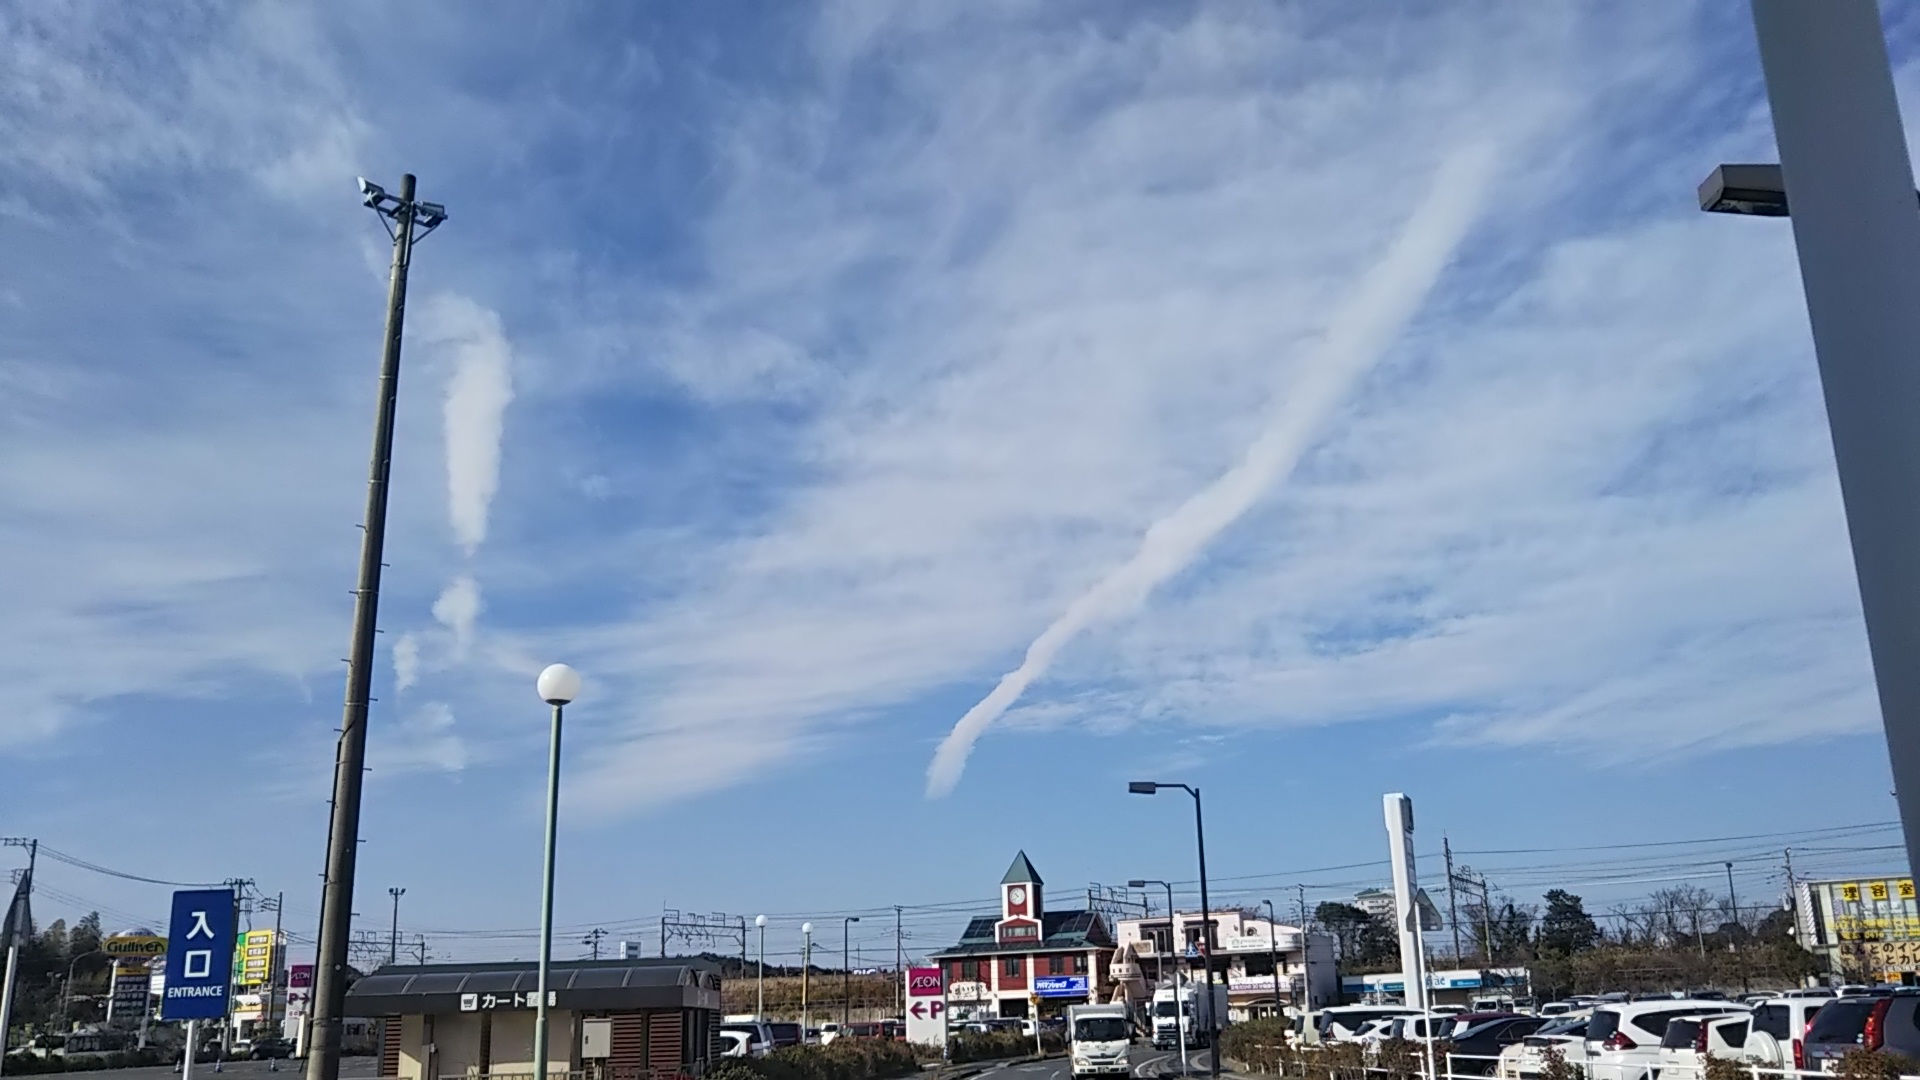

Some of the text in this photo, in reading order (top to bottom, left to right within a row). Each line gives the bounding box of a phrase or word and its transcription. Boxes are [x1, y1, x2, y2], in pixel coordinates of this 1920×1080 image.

[1843, 883, 1913, 898] 理容室
[107, 941, 164, 953] Gulliver
[184, 911, 215, 978] 入口
[167, 985, 223, 999] ENTRANCE
[930, 1001, 944, 1019] P
